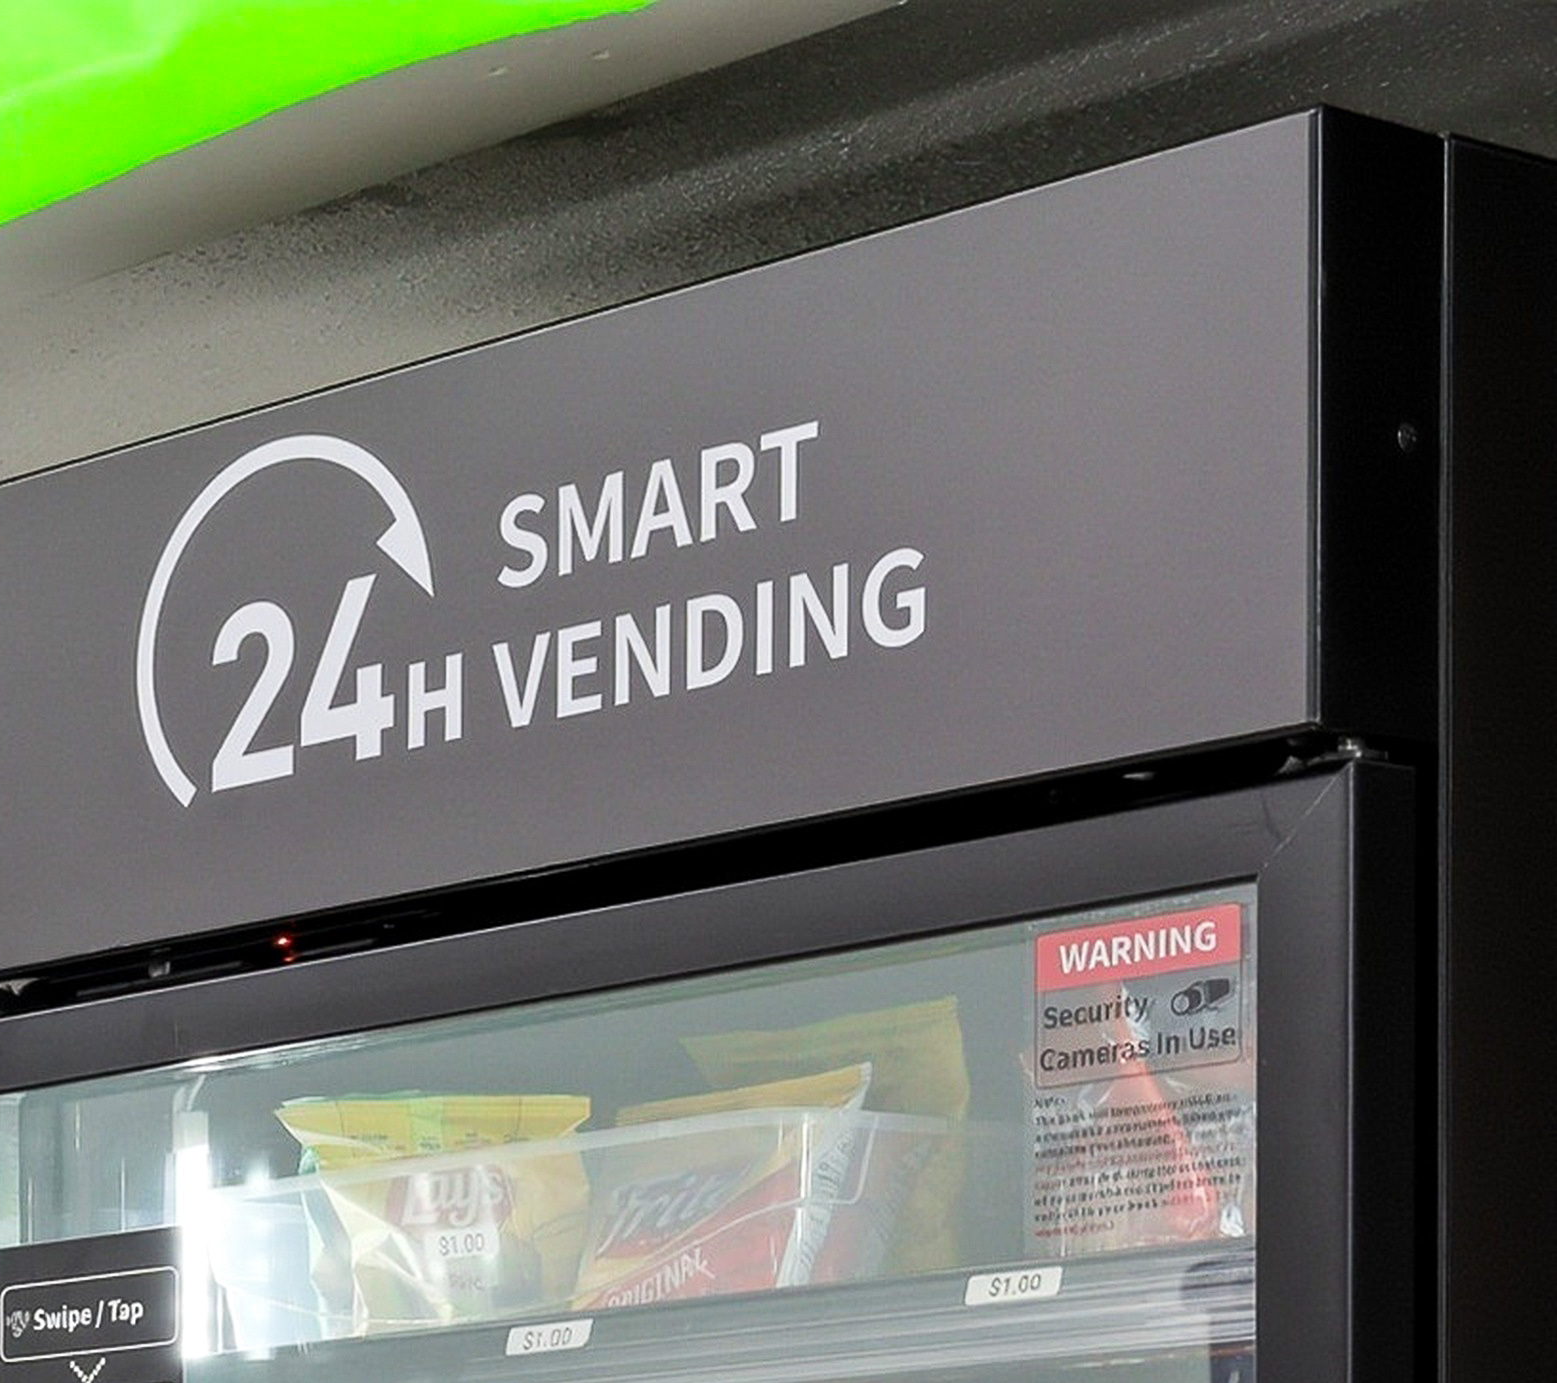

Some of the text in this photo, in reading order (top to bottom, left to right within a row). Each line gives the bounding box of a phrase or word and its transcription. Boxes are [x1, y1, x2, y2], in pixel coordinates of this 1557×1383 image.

[497, 421, 818, 589] SMART
[493, 548, 927, 729] VENDING
[1059, 921, 1217, 974] WARNING
[1043, 994, 1149, 1029] Security
[1039, 1026, 1237, 1071] Cameras In Use
[439, 1233, 485, 1256] $1.00
[989, 1273, 1043, 1298] $1.00
[33, 1304, 92, 1333] Swipe
[108, 1298, 144, 1325] Tap
[522, 1327, 574, 1350] $1.00
